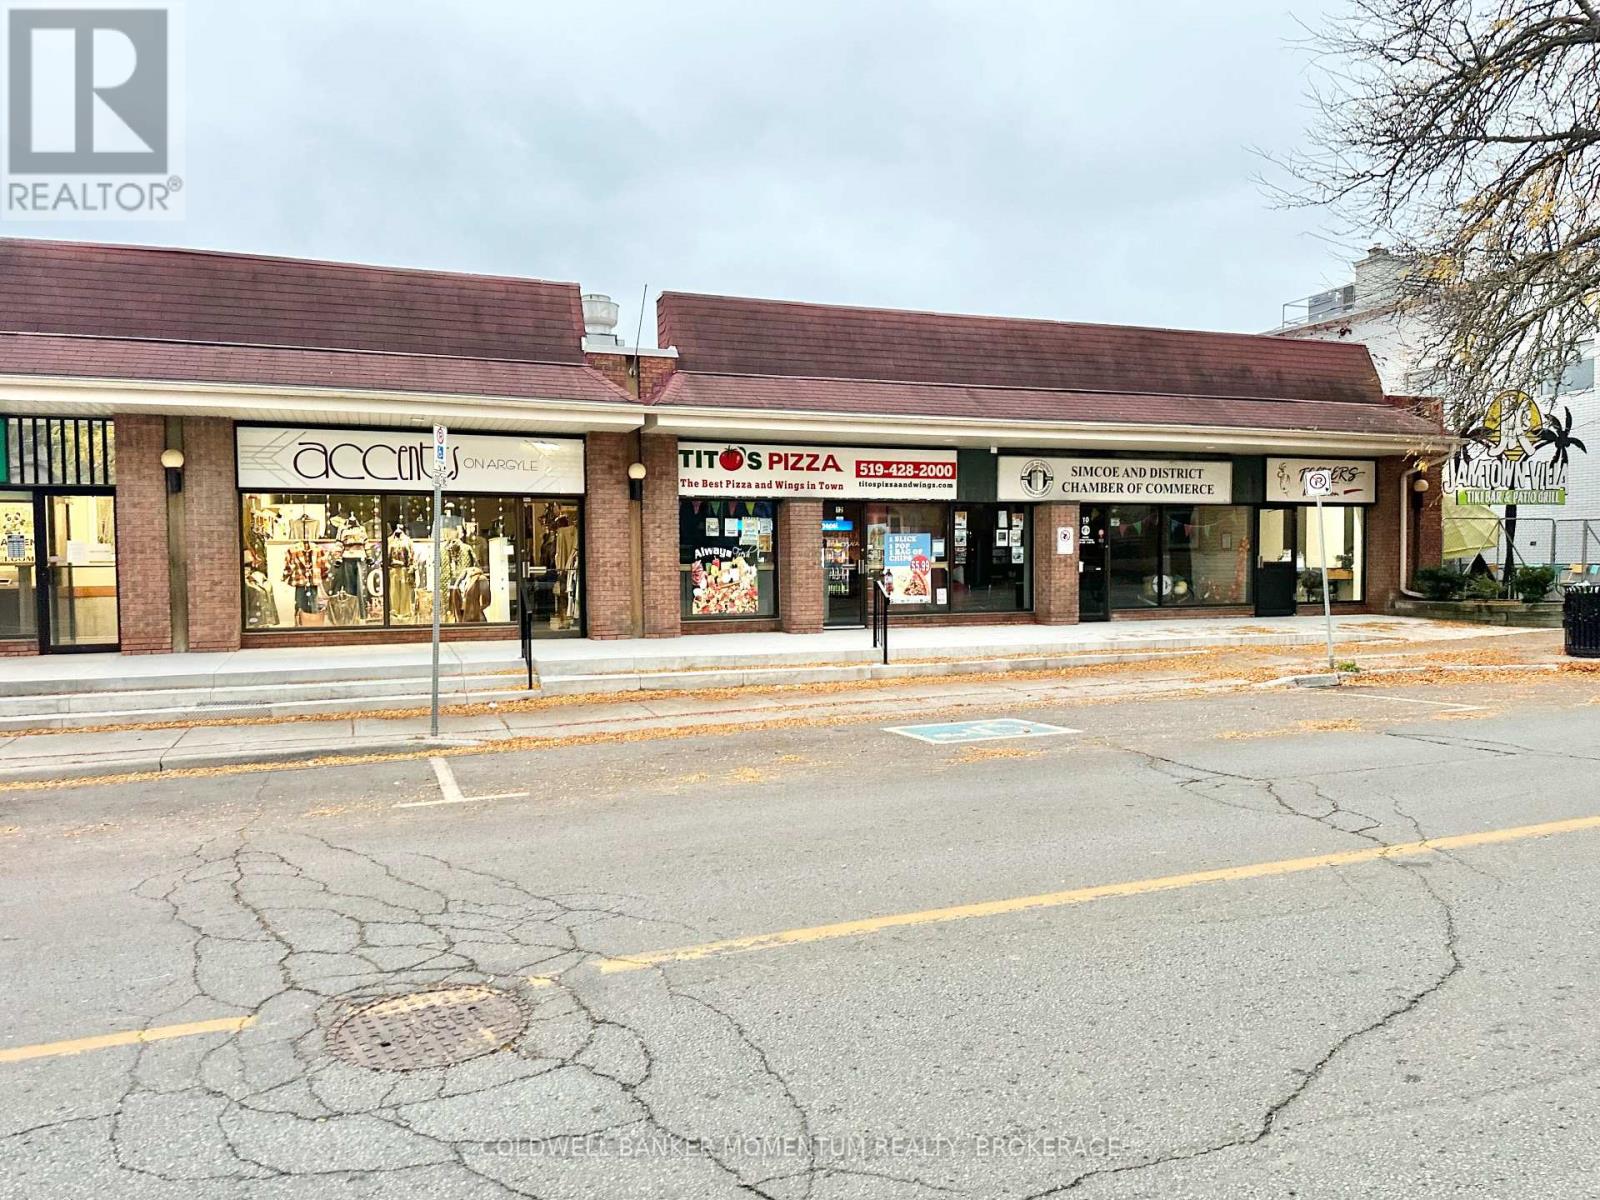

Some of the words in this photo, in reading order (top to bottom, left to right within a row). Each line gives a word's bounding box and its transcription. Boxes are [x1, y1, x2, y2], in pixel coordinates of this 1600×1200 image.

[463, 457, 486, 470] ON
[487, 459, 538, 471] ARGYLE
[768, 453, 843, 472] PIZZA
[860, 463, 953, 476] 519-428-2000
[1071, 466, 1120, 477] SIMCOE
[1122, 467, 1147, 478] AND
[1150, 468, 1204, 479] DISTRICT
[680, 479, 699, 488] The
[702, 480, 723, 488] Best
[726, 480, 751, 489] Pizza
[755, 480, 772, 489] and
[775, 481, 804, 491] Wings
[807, 481, 816, 490] in
[819, 482, 844, 490] Town
[1062, 482, 1124, 493] CHAMBER
[1127, 483, 1143, 494] OF
[1146, 484, 1215, 495] COMMERCE
[1514, 490, 1537, 504] PATIO
[694, 547, 732, 560] Always
